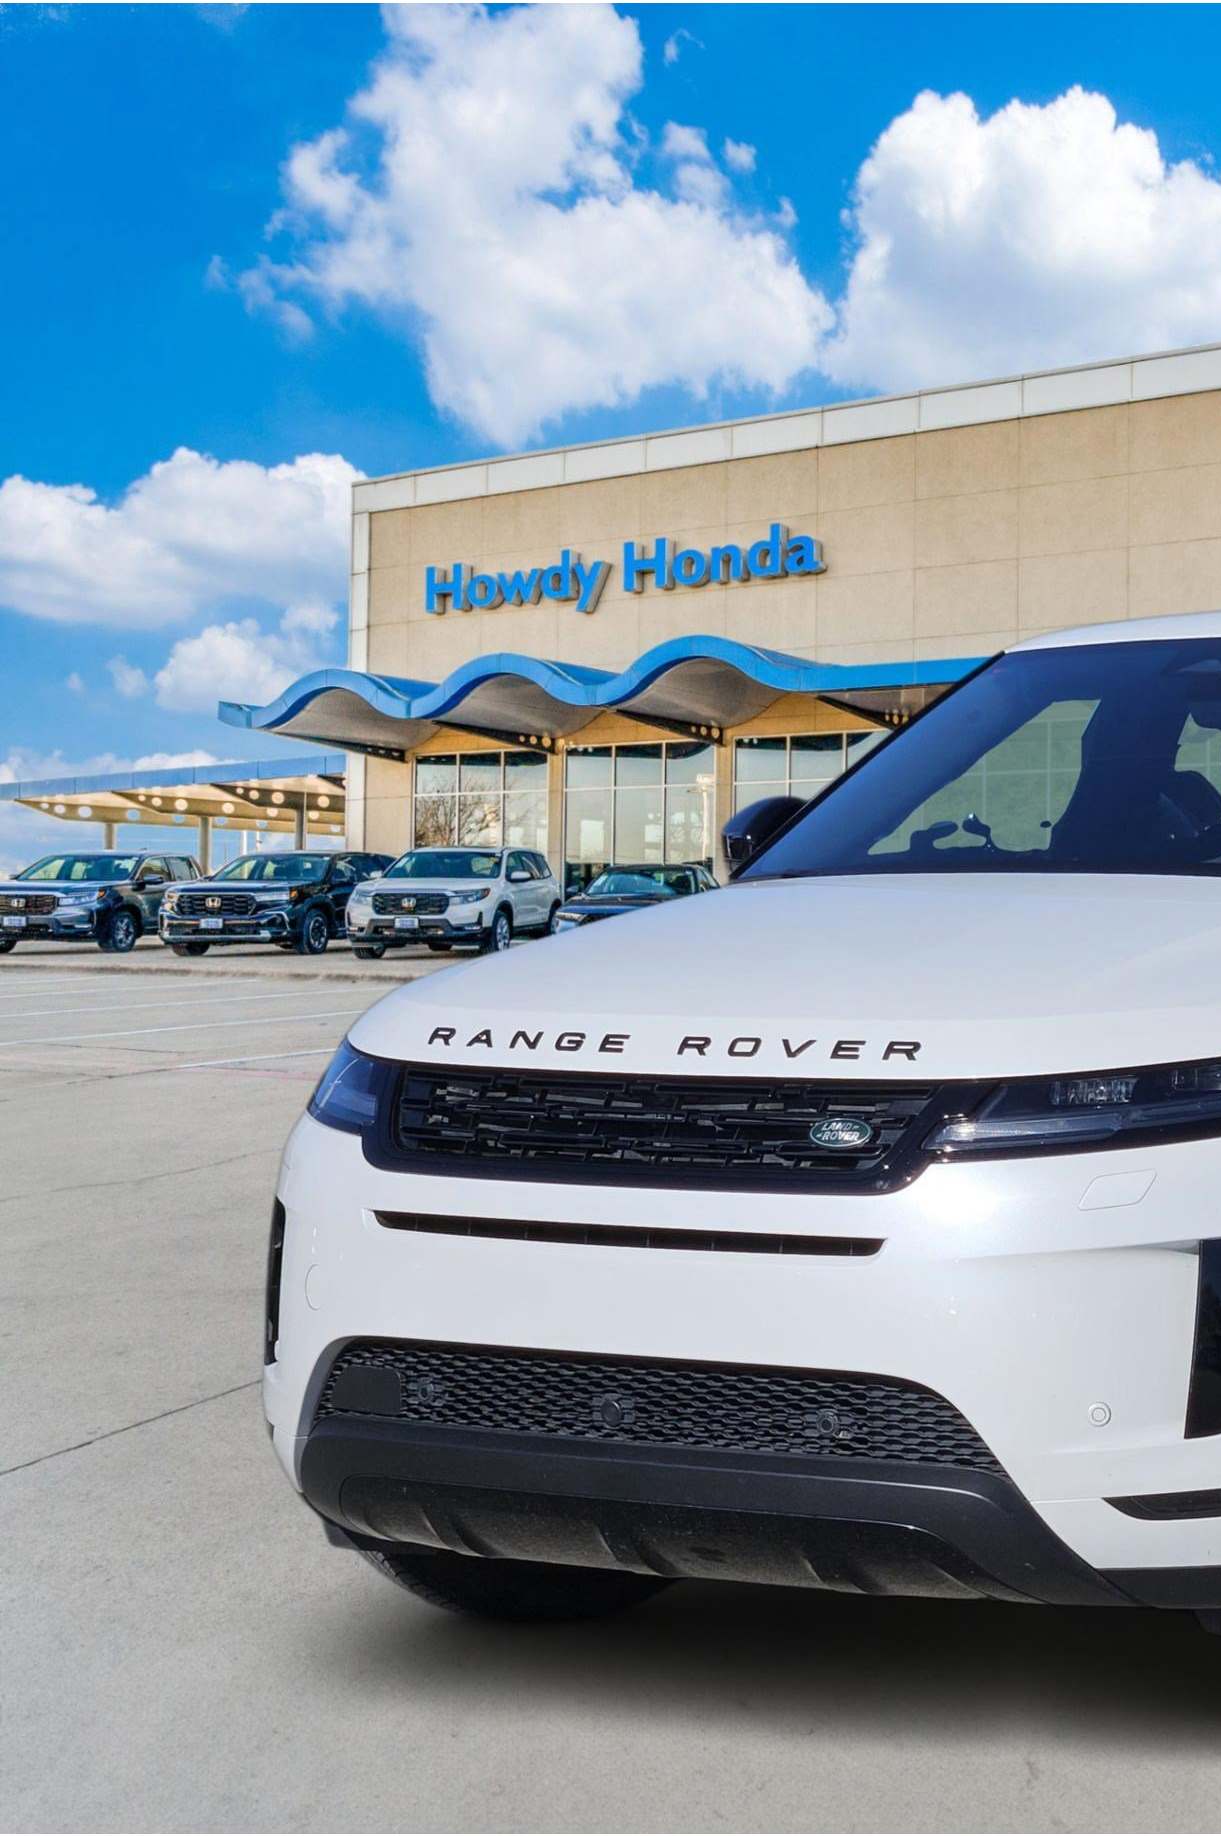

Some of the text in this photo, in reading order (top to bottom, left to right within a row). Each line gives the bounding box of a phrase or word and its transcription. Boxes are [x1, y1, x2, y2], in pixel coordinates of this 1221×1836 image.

[425, 522, 825, 614] Howdy Honda
[428, 1026, 922, 1062] RANGE ROVER
